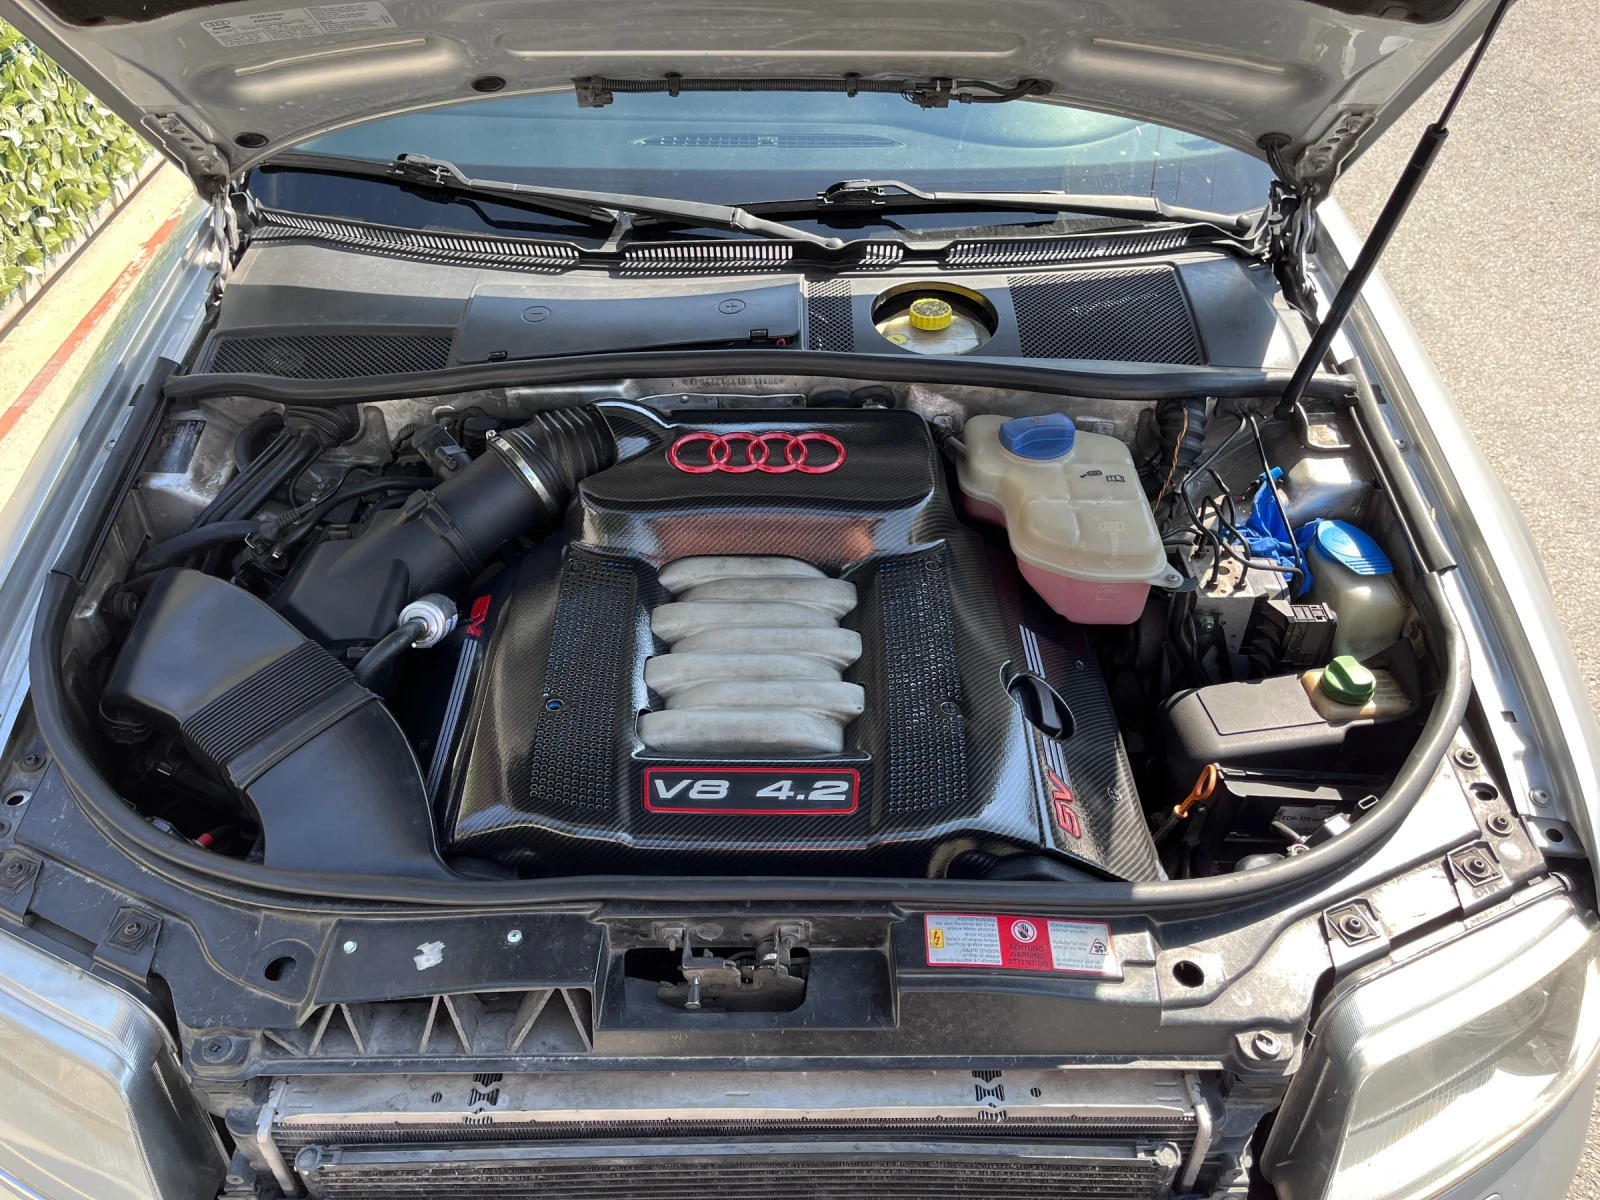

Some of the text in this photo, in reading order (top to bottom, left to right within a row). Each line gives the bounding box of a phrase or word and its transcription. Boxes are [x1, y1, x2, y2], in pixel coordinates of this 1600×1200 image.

[654, 779, 850, 801] V8 4.2
[1009, 944, 1044, 952] ACHTUNG
[1008, 959, 1049, 967] ATTENTION
